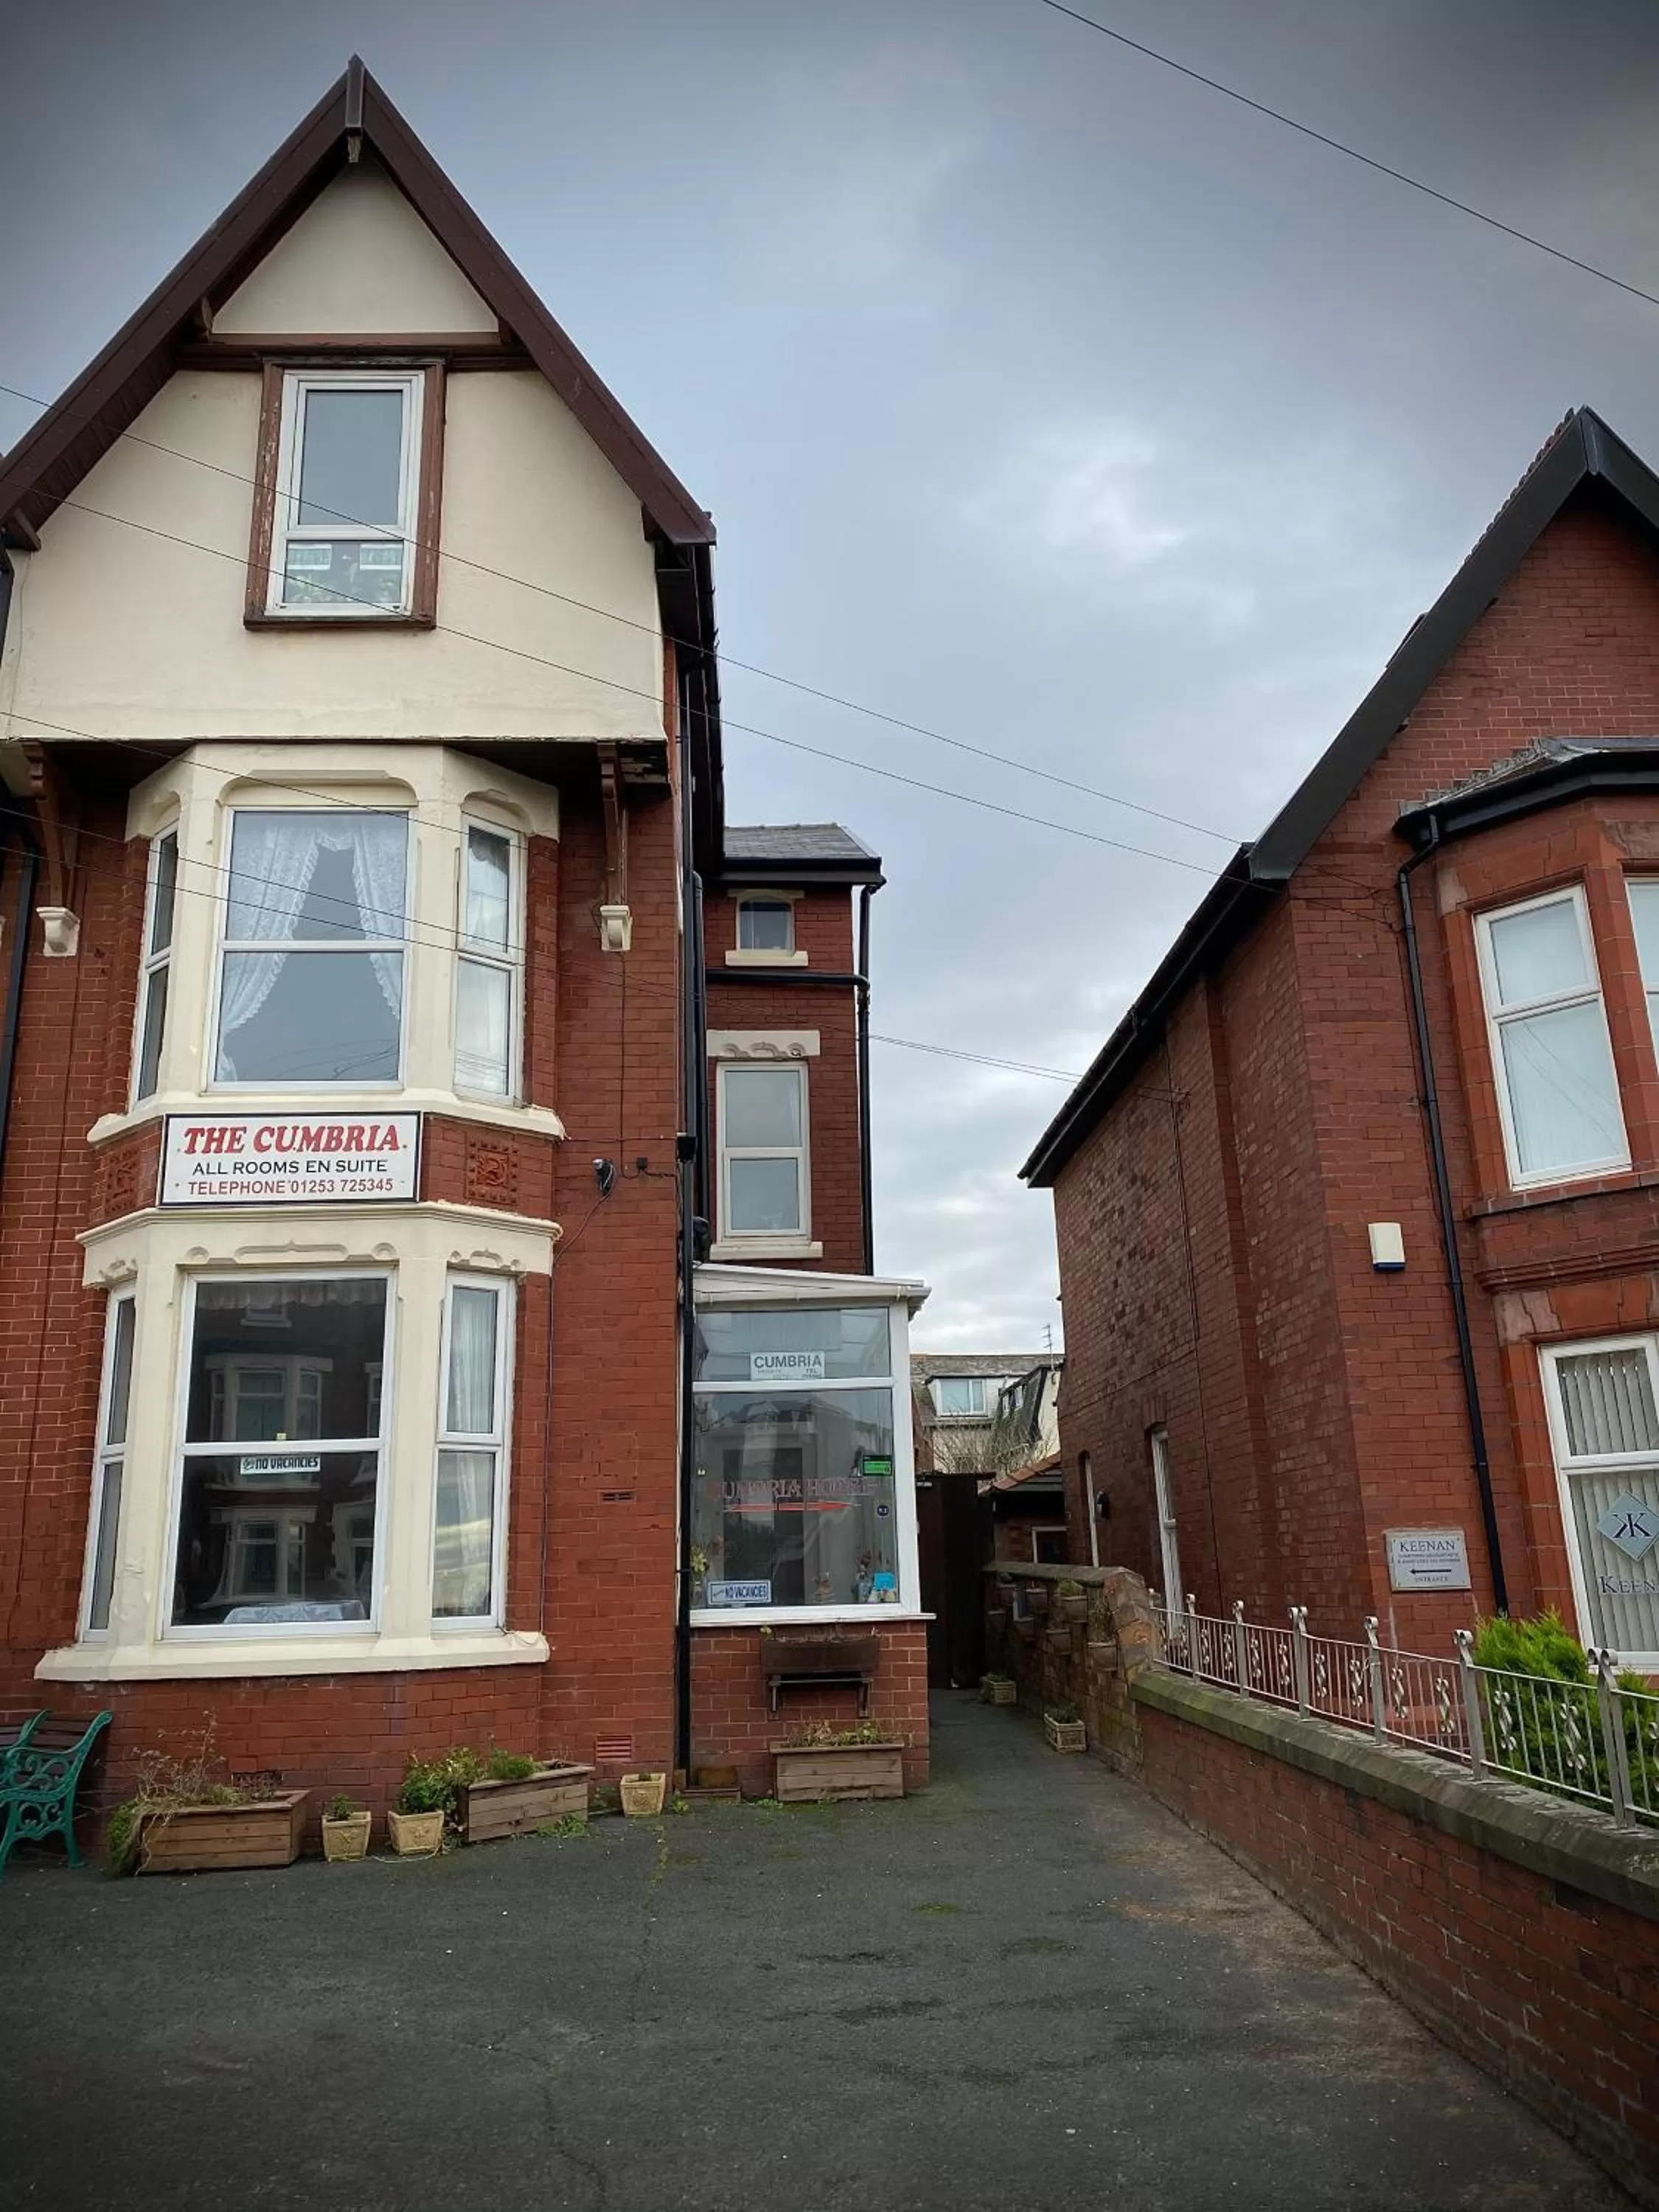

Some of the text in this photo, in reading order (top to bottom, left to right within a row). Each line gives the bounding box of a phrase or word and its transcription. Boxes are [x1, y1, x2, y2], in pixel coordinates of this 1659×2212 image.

[184, 1124, 400, 1155] THE CUMBRIA
[192, 1159, 388, 1176] ALL ROOMS EN SUITE
[188, 1178, 393, 1195] TELEPHONE 01253 725345
[754, 1354, 821, 1368] CUMBRIA
[255, 1458, 268, 1470] NO
[271, 1456, 319, 1469] VACANCIES
[1400, 1540, 1455, 1552] KEENAN
